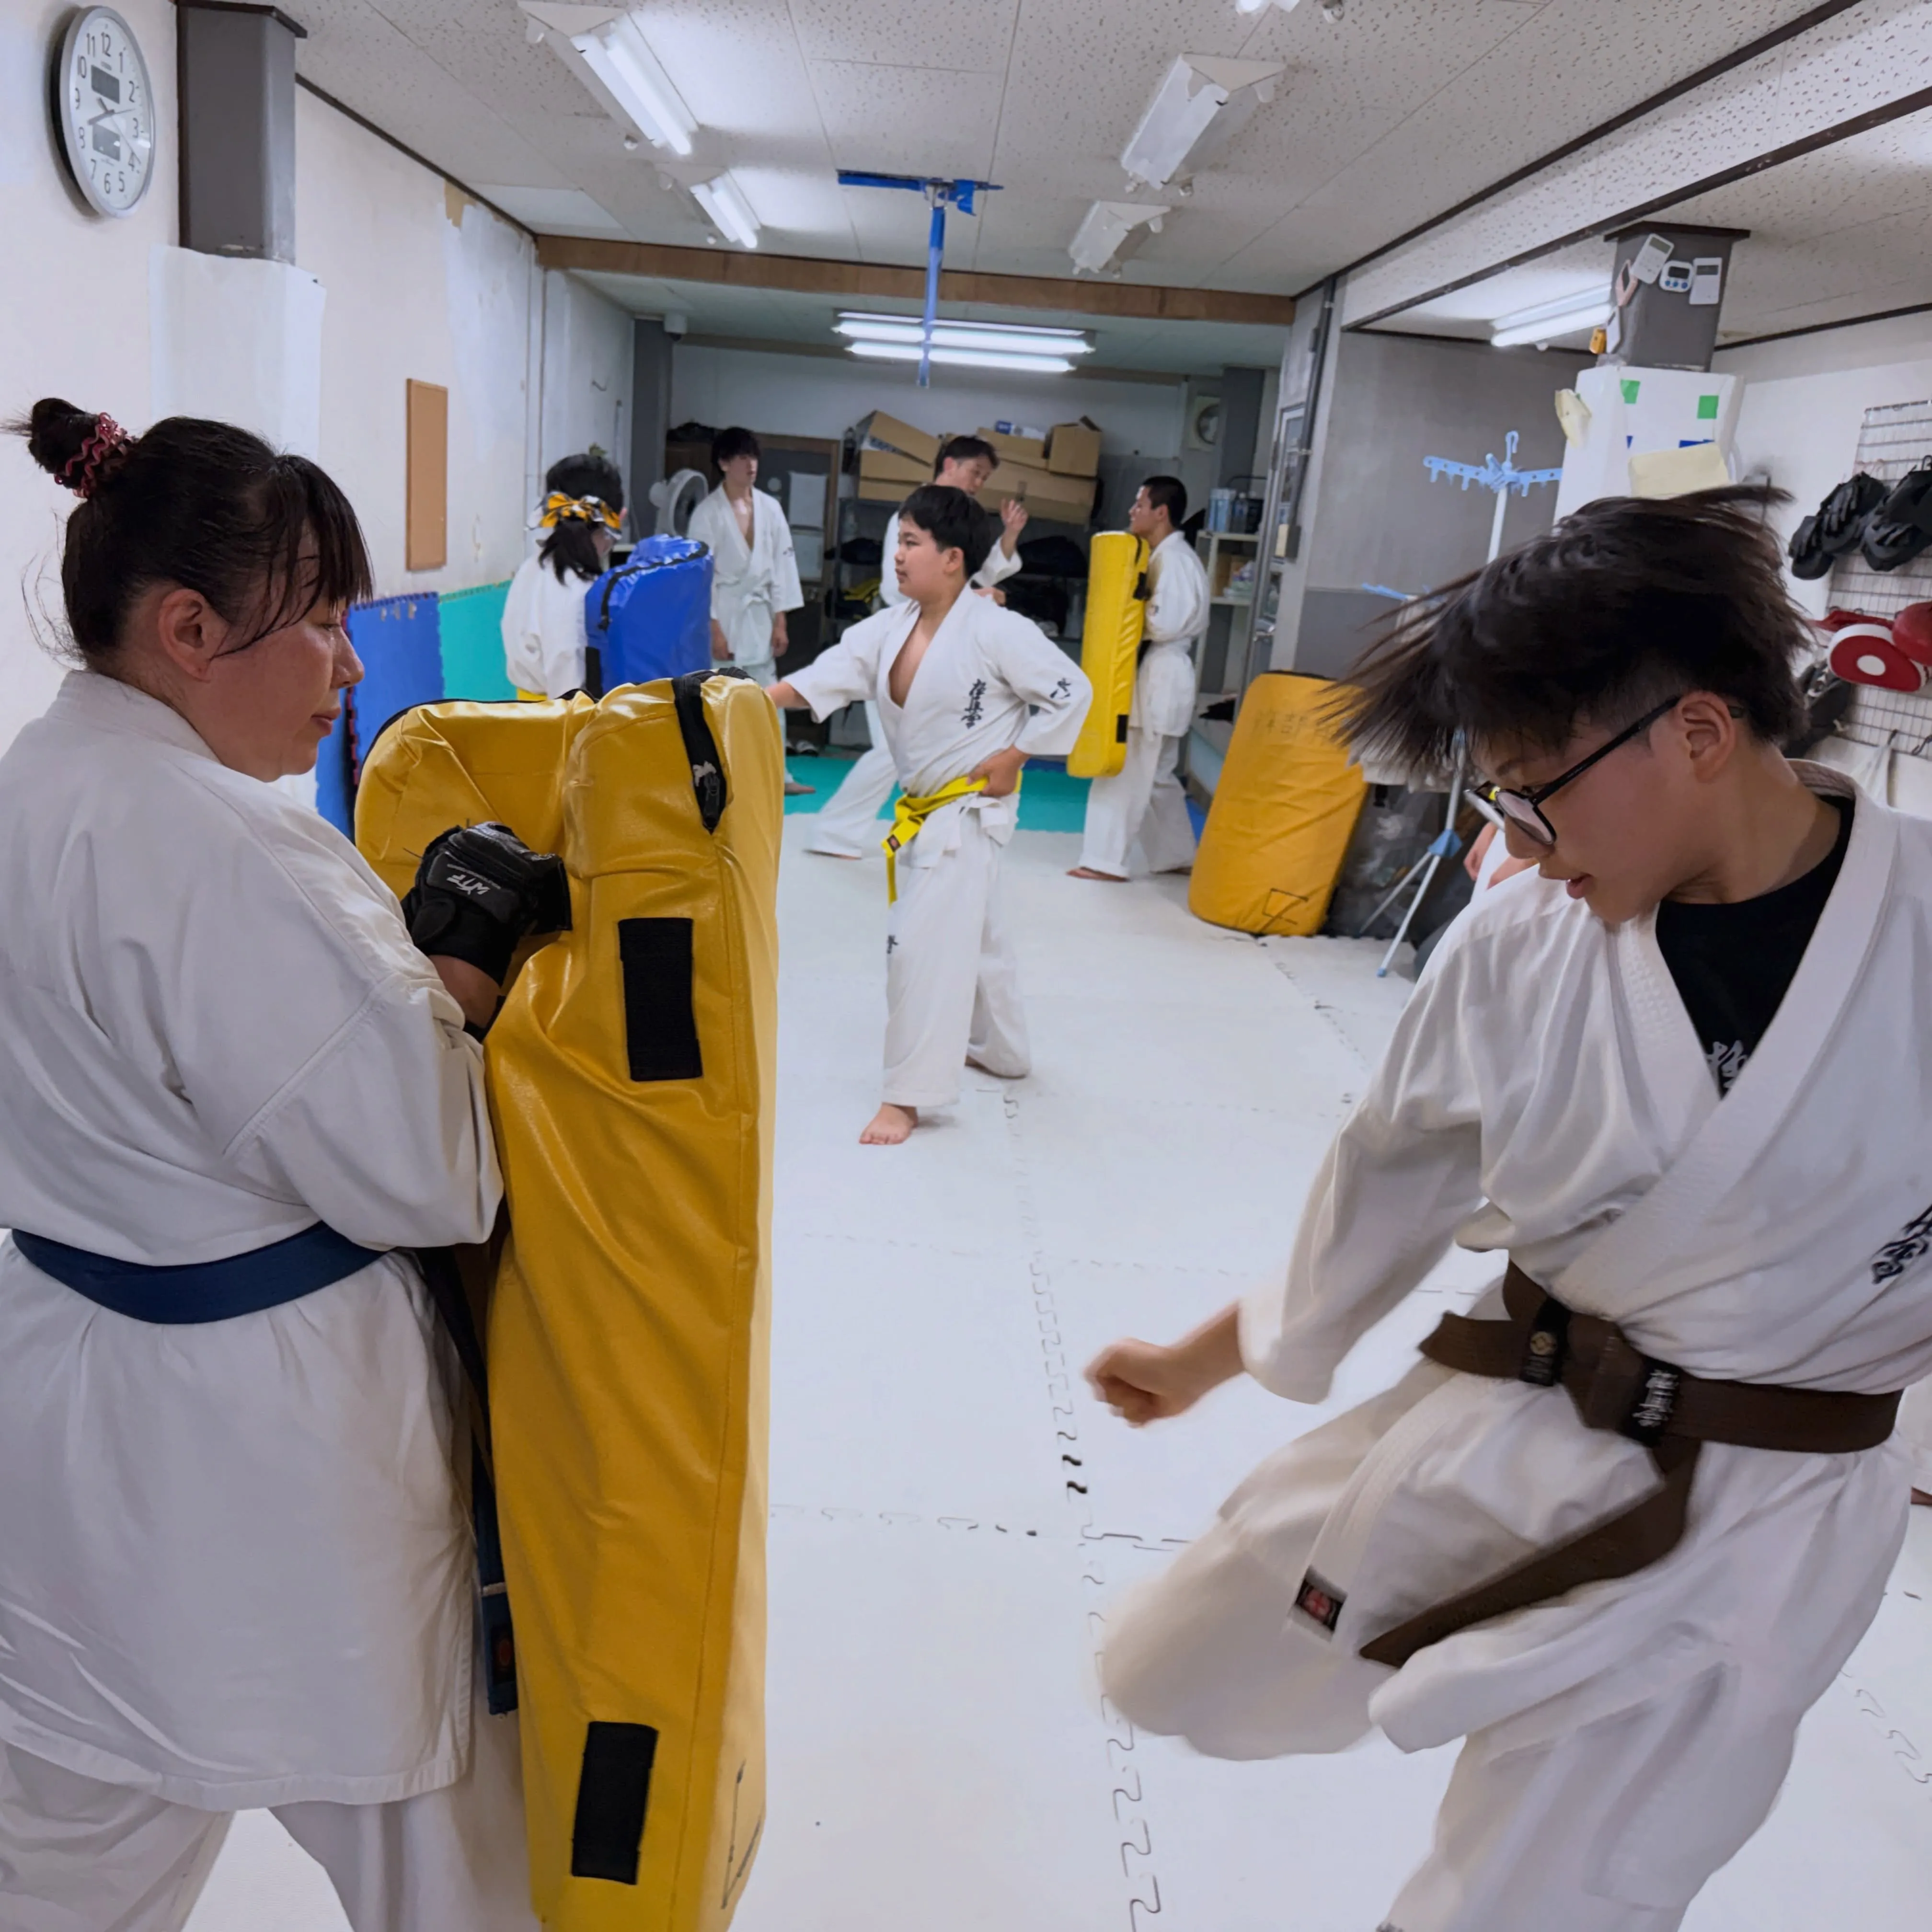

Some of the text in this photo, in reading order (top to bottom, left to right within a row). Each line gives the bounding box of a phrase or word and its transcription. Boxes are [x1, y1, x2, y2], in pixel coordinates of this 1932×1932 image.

[86, 33, 96, 58] 11
[101, 32, 112, 57] 12
[77, 54, 87, 79] 10
[119, 51, 123, 73] 1
[128, 80, 135, 103] 2
[78, 126, 85, 149] 8
[132, 117, 138, 138] 3
[90, 159, 97, 180] 7
[127, 152, 136, 172] 4
[104, 172, 111, 194] 6
[118, 171, 125, 192] 5
